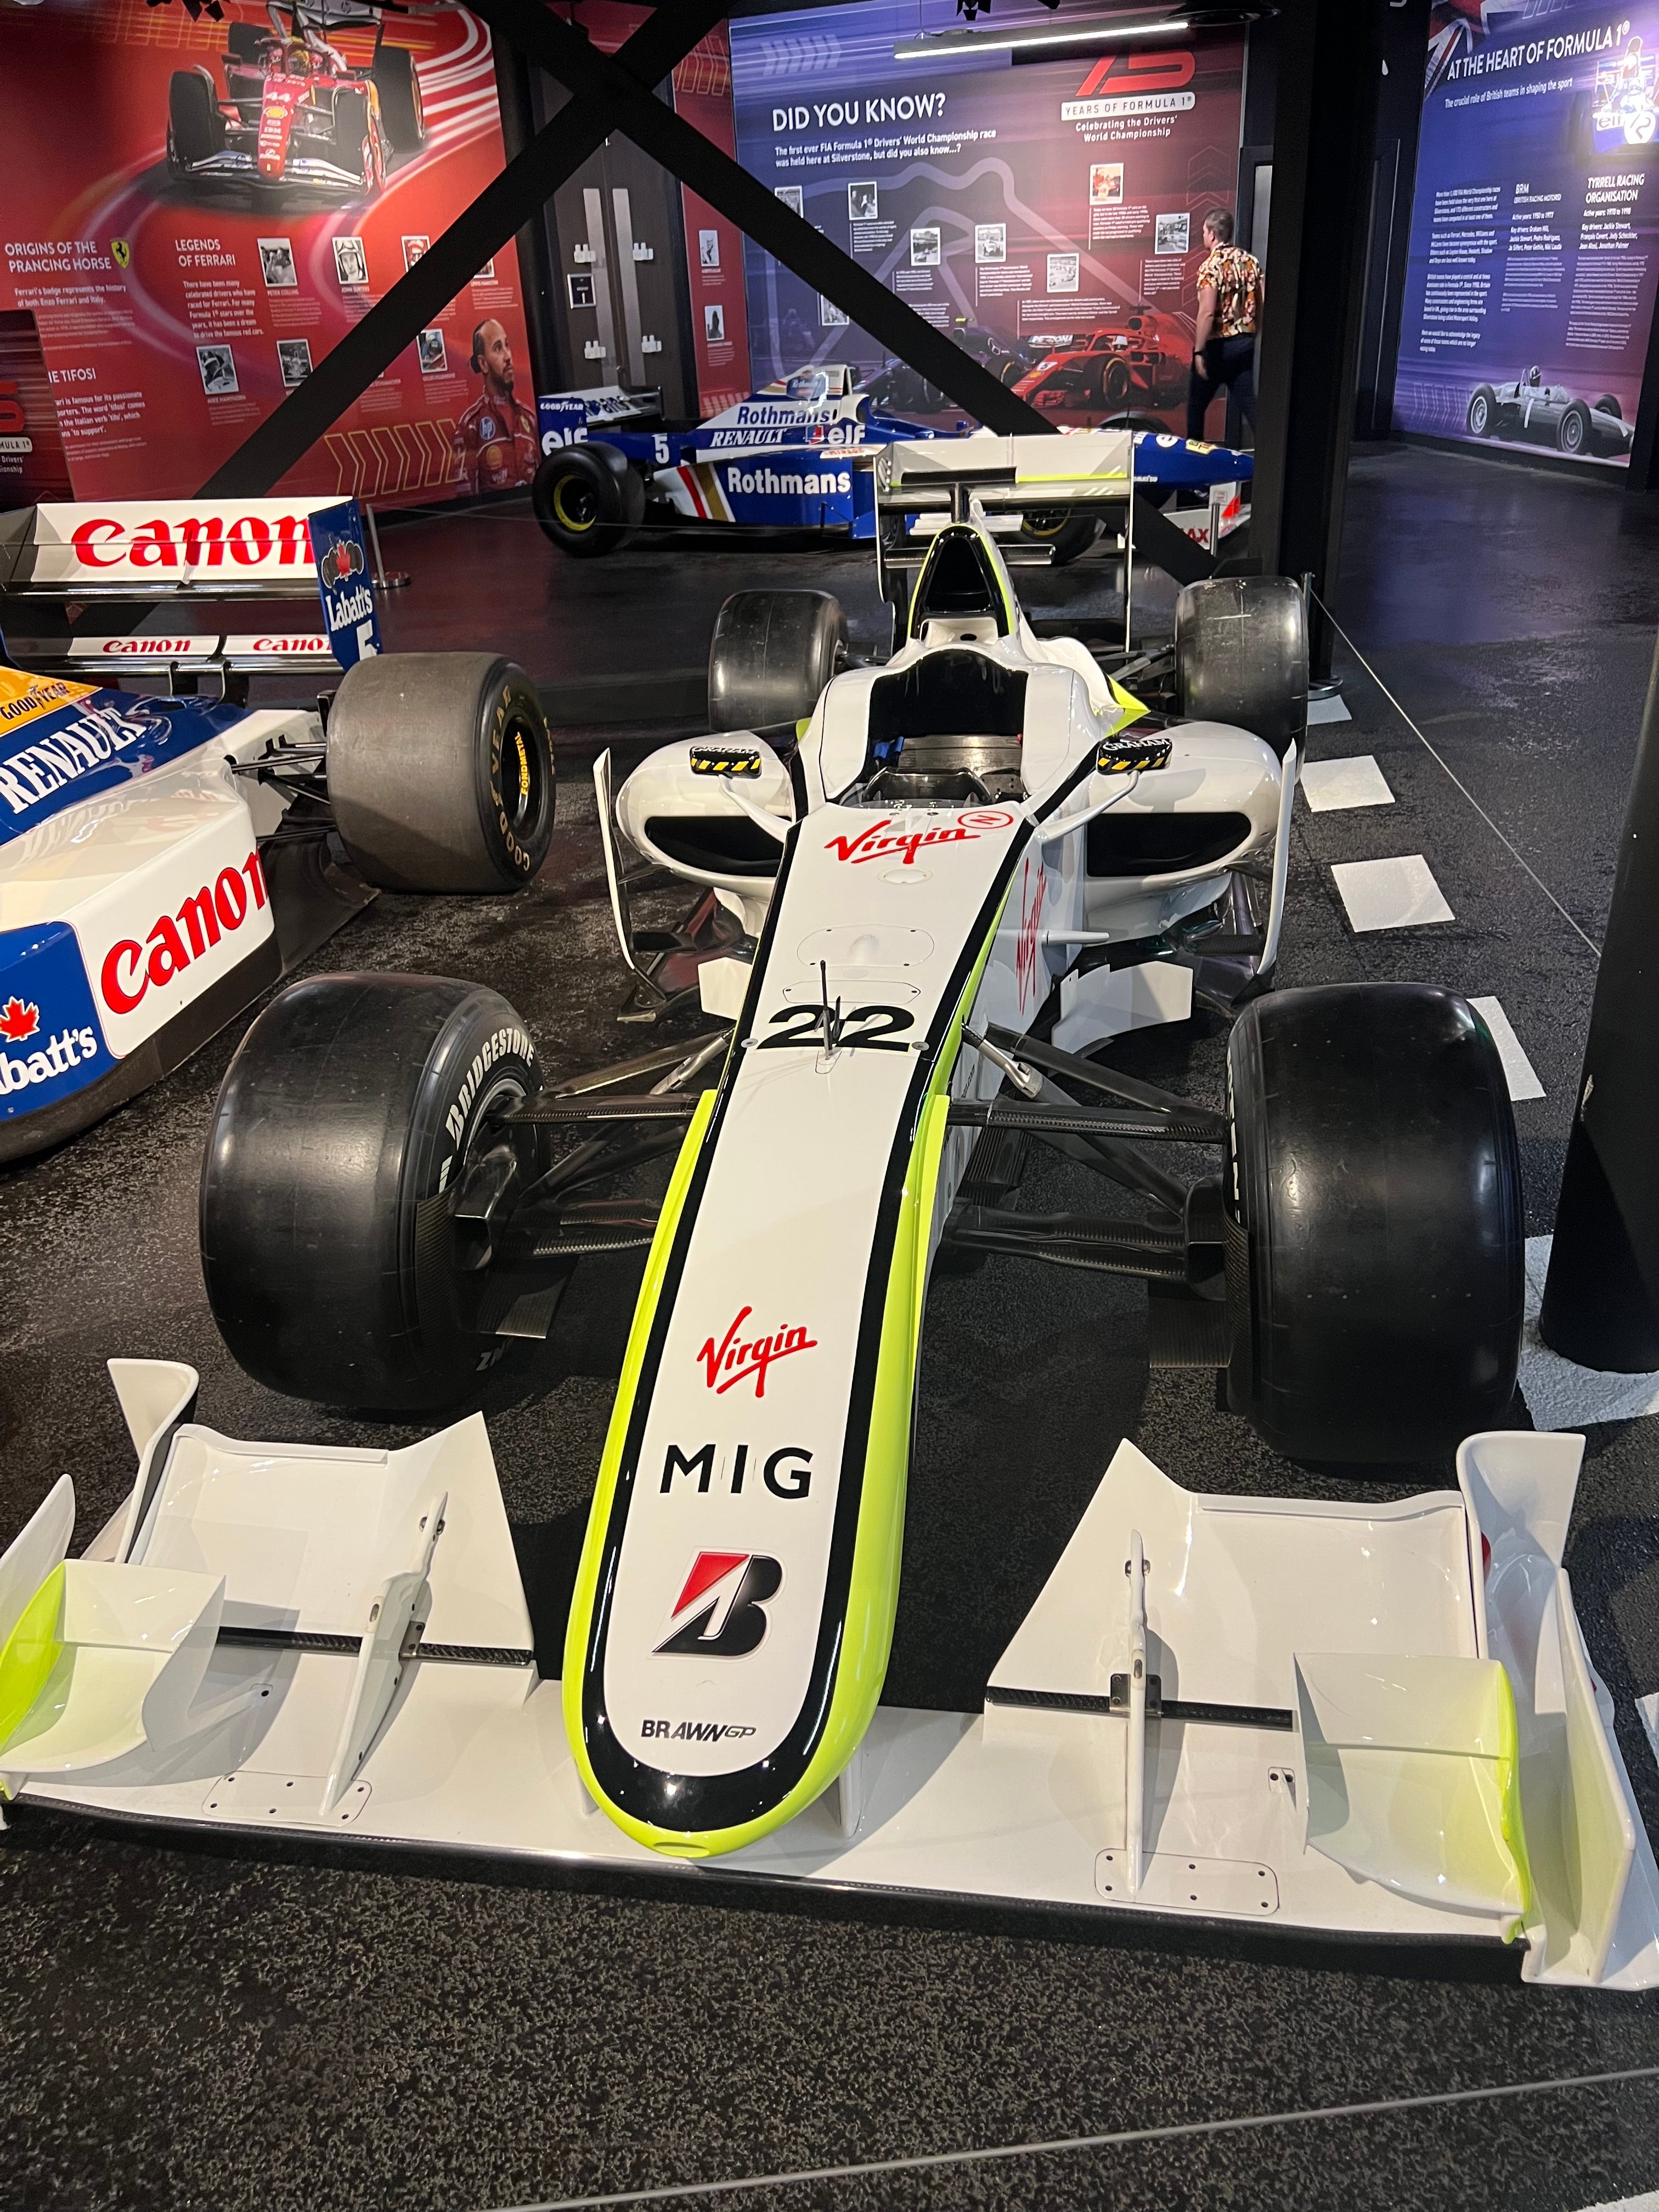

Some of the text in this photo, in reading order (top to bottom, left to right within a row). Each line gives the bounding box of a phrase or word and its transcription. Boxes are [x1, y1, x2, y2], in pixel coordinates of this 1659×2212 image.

[1447, 60, 1460, 80] AT
[1463, 54, 1483, 77] THE
[1486, 44, 1525, 72] HEART
[1526, 41, 1545, 64] OF
[1546, 26, 1612, 60] FORMULA
[1445, 77, 1573, 108] The crucial role of British teams in shaping the sport
[772, 93, 946, 132] DID YOU KNOW?
[1065, 104, 1099, 116] YEARS
[1105, 103, 1117, 112] OF
[1123, 98, 1176, 111] FORMULA
[1076, 115, 1177, 132] Celebrating the Drivers'
[775, 145, 787, 156] The
[789, 145, 802, 155] first
[804, 145, 819, 154] ever
[820, 142, 832, 152] FIA
[833, 140, 862, 151] Formula
[904, 134, 926, 145] World
[927, 129, 978, 143] Championship
[980, 129, 996, 138] race
[1084, 127, 1171, 143] World Championship
[776, 159, 789, 167] was
[791, 155, 805, 166] held
[806, 156, 821, 165] here
[823, 154, 830, 163] at
[832, 152, 872, 163] Silverstone,
[873, 149, 885, 159] but
[887, 148, 898, 158] did
[899, 149, 912, 159] you
[913, 146, 929, 156] also
[1515, 183, 1529, 194] BRM
[1588, 173, 1645, 189] TYRRELL RACING
[1585, 189, 1638, 204] ORGANISATION
[5, 241, 97, 256] ORIGINS OF THE
[175, 239, 221, 252] LEGENDS
[9, 257, 112, 273] PRANCING HORSE
[179, 253, 236, 267] OF FERRARI
[43, 286, 61, 296] badge
[56, 296, 77, 305] Ferrari
[60, 368, 96, 383] TIFOSI
[57, 409, 81, 417] porters.
[737, 405, 831, 425] Rothmans
[542, 427, 589, 456] elf
[710, 428, 787, 447] RENAULT
[828, 425, 865, 444] elf
[655, 435, 669, 465] 5
[727, 467, 851, 494] Rothmans
[71, 515, 317, 568] Canon
[325, 584, 373, 632] Labatt's
[103, 638, 191, 654] Canon
[253, 637, 332, 653] Cano
[1103, 738, 1170, 751] GRAHAM
[0, 707, 147, 815] RENAULT
[515, 731, 531, 797] FONDMETAL
[823, 820, 981, 865] Virgin
[101, 847, 268, 1014] Canon
[756, 1004, 915, 1053] 22
[0, 1026, 98, 1095] batt's
[445, 1028, 535, 1151] BRIDGESTONE
[697, 1305, 817, 1398] Virgin
